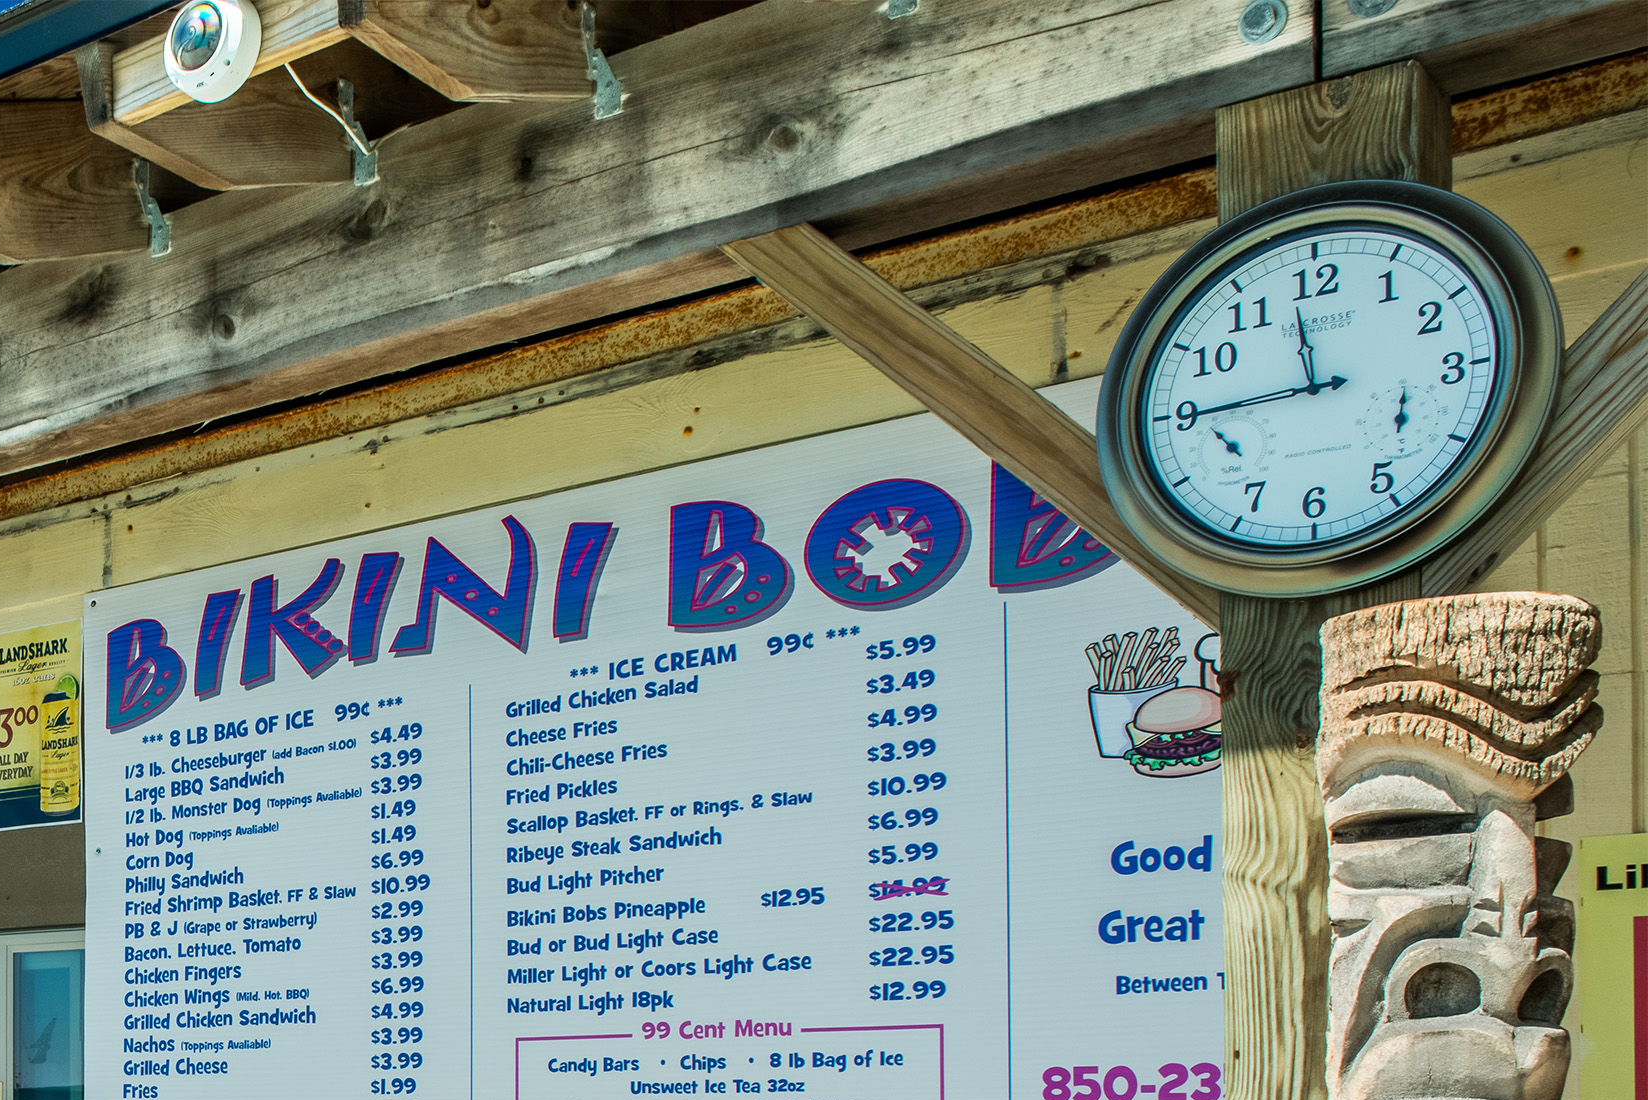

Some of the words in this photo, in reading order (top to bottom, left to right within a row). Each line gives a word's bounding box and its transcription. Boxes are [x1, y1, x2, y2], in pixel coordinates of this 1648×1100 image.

[1292, 262, 1340, 301] 12
[1378, 269, 1400, 304] 1
[1227, 295, 1273, 334] 11
[1281, 323, 1296, 331] LA
[1303, 311, 1352, 327] CROSSE
[1417, 300, 1443, 336] 2
[1193, 341, 1239, 378] 10
[1441, 351, 1467, 385] 3
[1176, 400, 1198, 431] 9
[1370, 459, 1396, 494] 5
[1244, 479, 1267, 513] 7
[1302, 486, 1327, 519] 6
[106, 515, 621, 736] BIKINI
[0, 638, 68, 665] LANDSHARK
[18, 659, 48, 674] Lager
[609, 656, 645, 681] ICE
[654, 643, 738, 673] CREAM
[33, 673, 55, 683] cans
[505, 694, 562, 718] Grilled
[568, 687, 638, 709] Chicken
[644, 674, 700, 699] Salad
[866, 633, 937, 661] $5.99
[42, 736, 78, 750] LANDSHARK
[169, 729, 181, 748] 8
[186, 725, 209, 745] LB
[214, 718, 249, 742] BAG
[254, 714, 280, 736] OF
[285, 708, 315, 731] ICE
[506, 750, 615, 776] Chili-Cheese
[621, 743, 669, 763] Fries
[867, 702, 939, 729] $4.99
[14, 752, 29, 764] DAY
[125, 762, 145, 780] 1/3
[149, 761, 166, 778] lb.
[171, 748, 268, 775] Cheeseburger
[271, 747, 293, 760] (add
[295, 744, 325, 757] Bacon
[327, 737, 357, 751] $1.00)
[370, 722, 423, 745] $4.49
[125, 831, 150, 848] Hot
[155, 828, 184, 849] Dog
[188, 828, 233, 843] (Toppings
[370, 798, 417, 820] $1.49
[125, 854, 160, 871] Corn
[165, 851, 194, 871] Dog
[371, 824, 417, 845] $1.49
[1111, 834, 1214, 876] Good
[507, 908, 557, 928] Bikini
[563, 904, 608, 924] Bobs
[614, 897, 706, 921] Pineapple
[760, 886, 826, 908] $12.95
[1098, 909, 1206, 945] Great
[507, 995, 572, 1014] Natural
[578, 991, 625, 1016] Light
[632, 990, 675, 1013] 18pk
[869, 979, 947, 1001] $12.99
[1116, 975, 1209, 996] Between
[123, 1012, 171, 1031] Grilled
[175, 1010, 234, 1029] Chicken
[239, 1004, 317, 1026] Sandwich
[371, 1001, 425, 1020] $4.99
[641, 1021, 671, 1040] 99
[679, 1020, 726, 1040] Cent
[734, 1018, 793, 1038] Menu
[548, 1057, 598, 1077] Candy
[603, 1056, 641, 1073] Bars
[680, 1053, 727, 1074] Chips
[769, 1052, 783, 1068] 8
[789, 1052, 806, 1069] lb
[812, 1051, 848, 1073] Bag
[854, 1049, 874, 1068] of
[880, 1050, 904, 1067] Ice
[122, 1083, 159, 1099] Fries
[370, 1077, 417, 1095] $1.99
